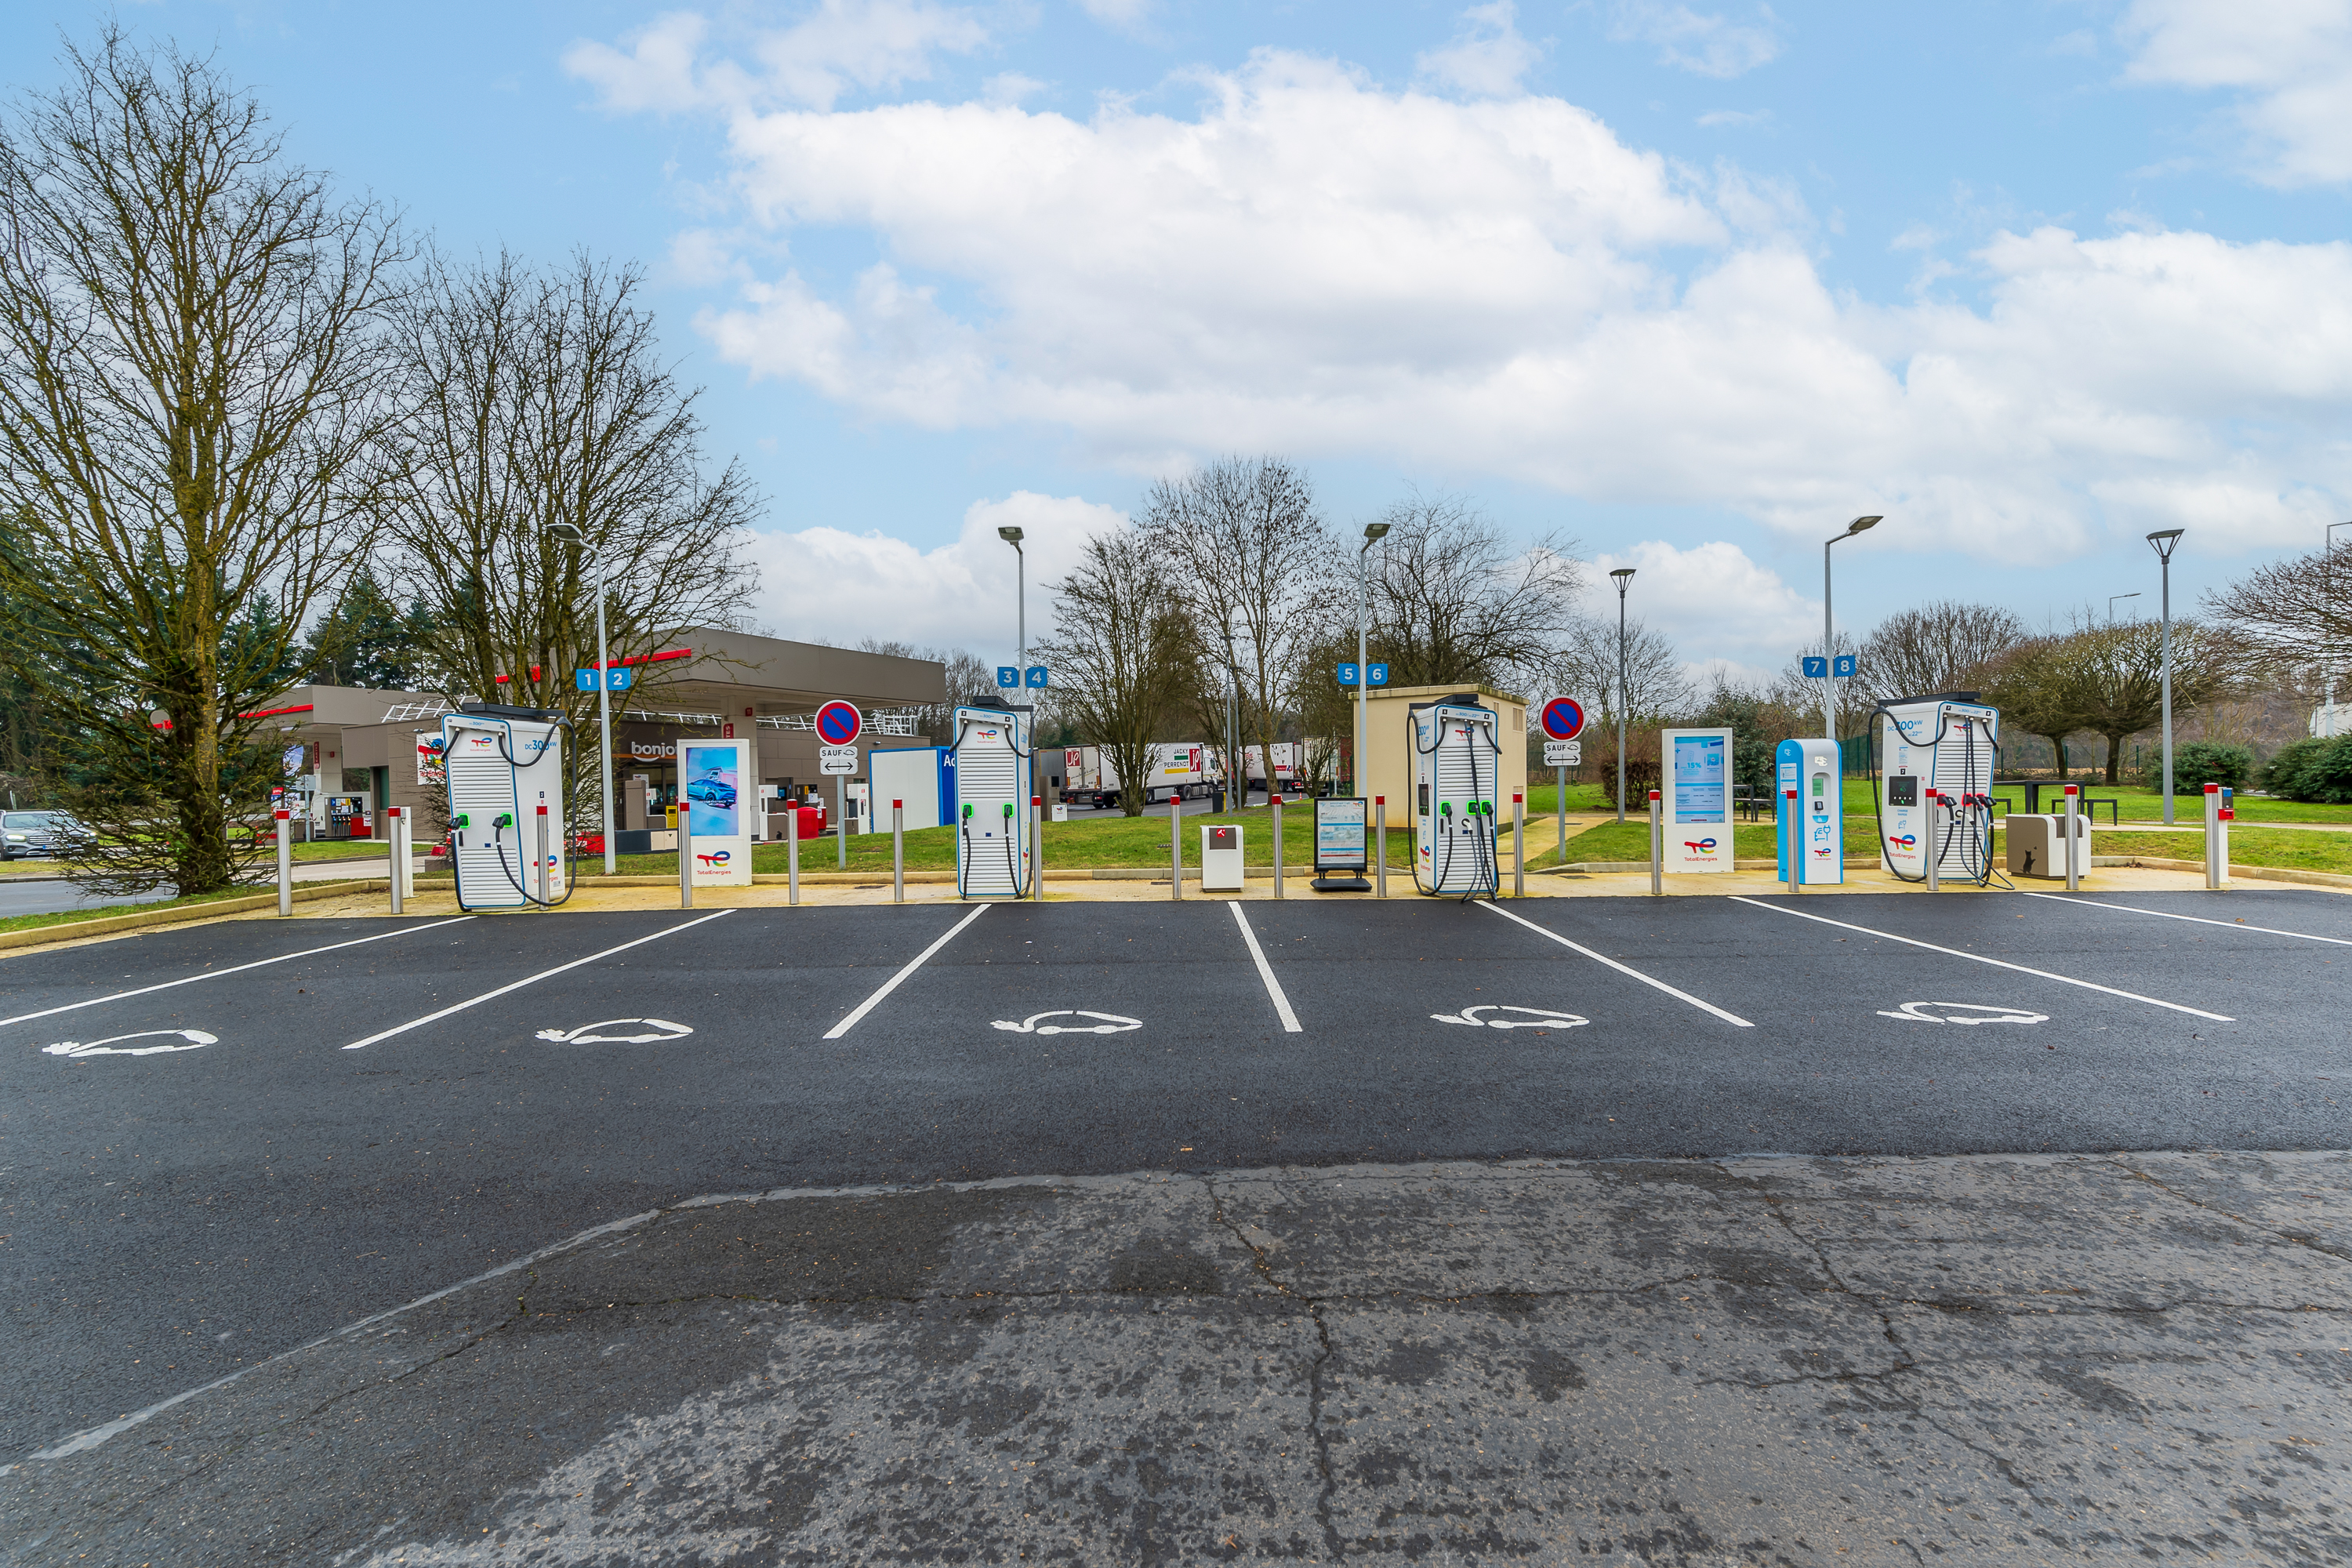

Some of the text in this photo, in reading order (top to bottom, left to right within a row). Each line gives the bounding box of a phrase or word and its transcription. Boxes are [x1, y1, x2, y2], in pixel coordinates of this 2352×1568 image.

[1811, 661, 1820, 673] 7
[1840, 660, 1850, 672] 8
[585, 673, 591, 686] 1
[613, 673, 622, 685] 2
[1004, 671, 1012, 683] 3
[1031, 671, 1042, 683] 4
[1344, 668, 1353, 680] 5
[1372, 668, 1382, 680] 6
